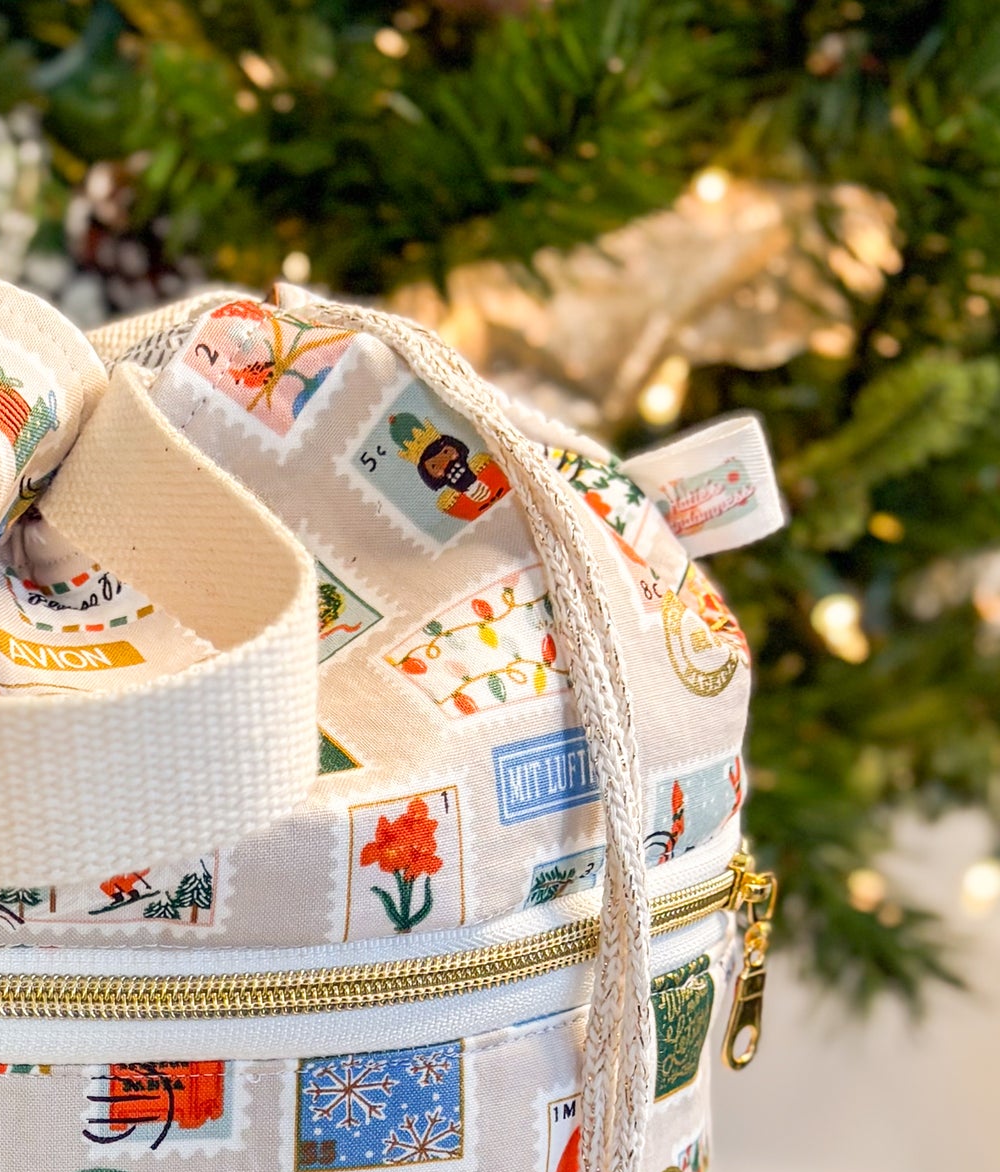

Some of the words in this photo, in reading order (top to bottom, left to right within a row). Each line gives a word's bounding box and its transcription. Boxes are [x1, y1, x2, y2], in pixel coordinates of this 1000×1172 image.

[194, 343, 220, 367] 2
[8, 637, 113, 670] AVION
[506, 759, 546, 804] MIT
[440, 790, 450, 815] 1
